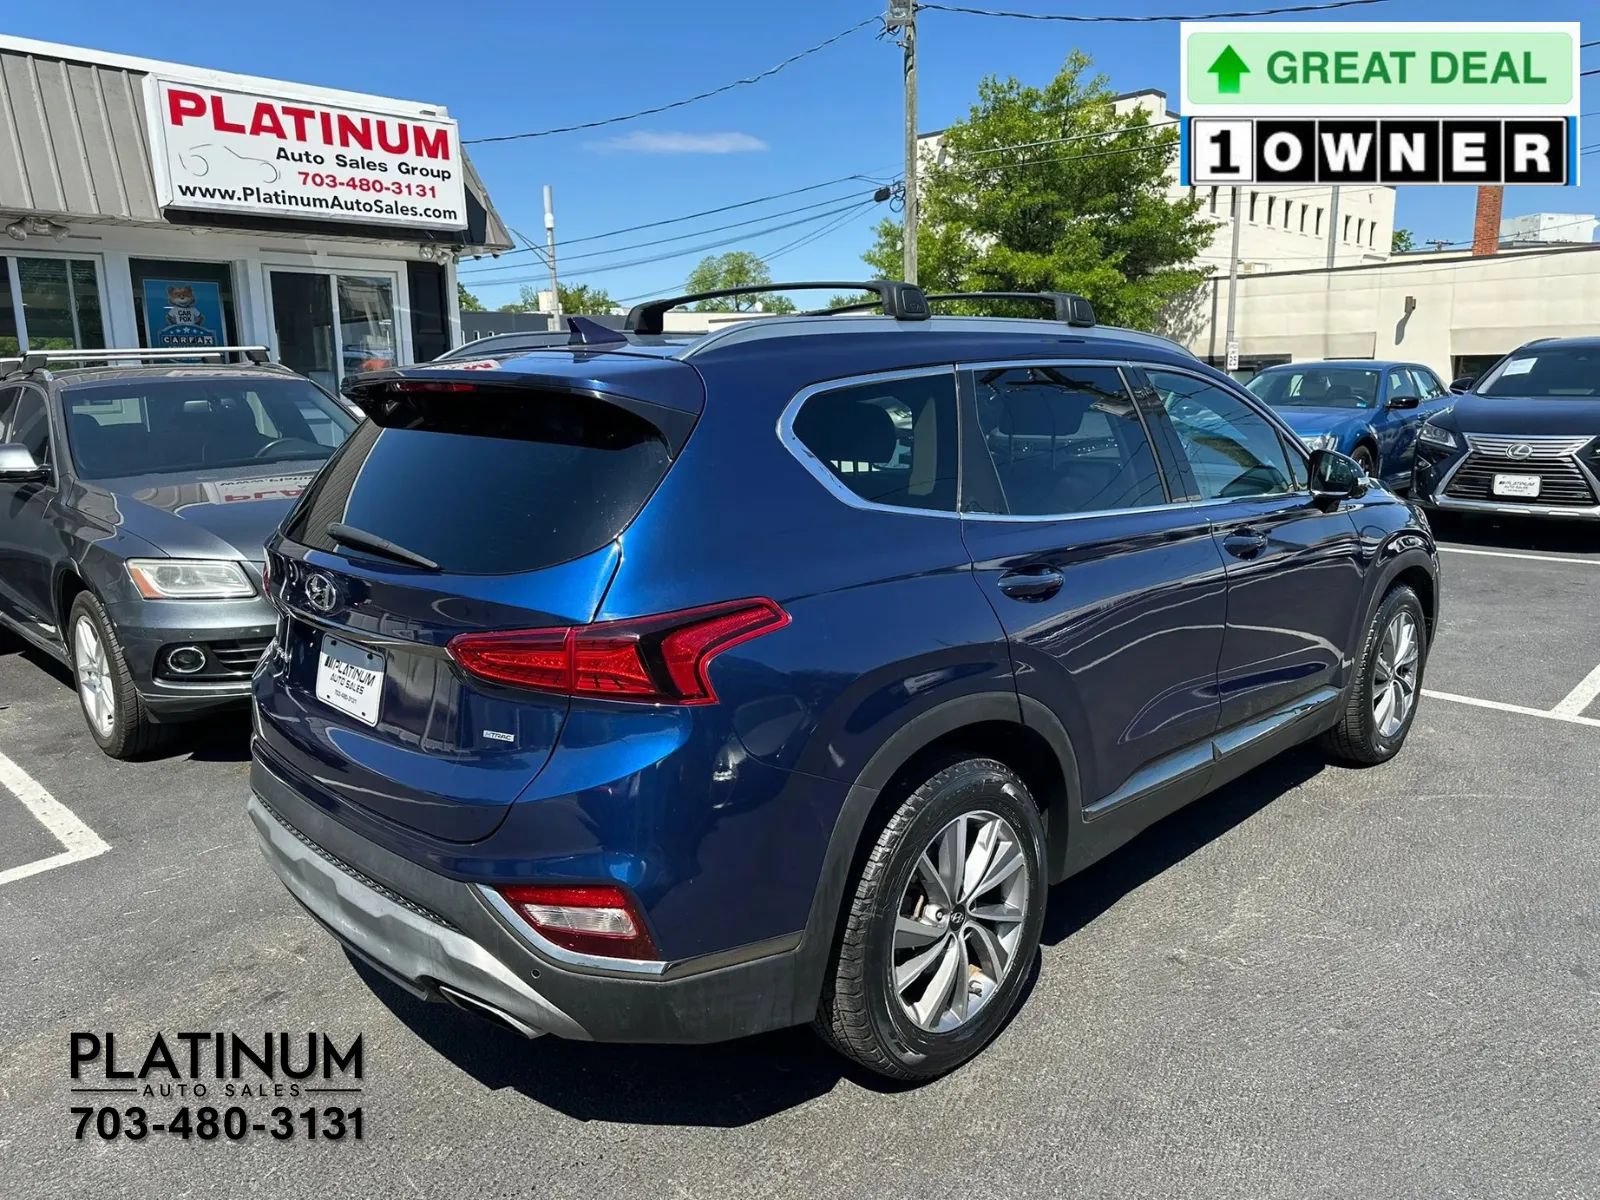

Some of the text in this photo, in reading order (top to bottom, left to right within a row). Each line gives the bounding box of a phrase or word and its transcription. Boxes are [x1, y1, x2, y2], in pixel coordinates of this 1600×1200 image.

[167, 88, 451, 161] PLATINUM
[275, 146, 452, 181] Auto Sales Group
[297, 171, 437, 199] 703-480-3131
[178, 184, 458, 221] www.PlatinumAutoSales.com
[163, 335, 213, 345] CARFAX
[330, 673, 365, 695] AUTO SALES
[333, 659, 376, 687] PLATINUM
